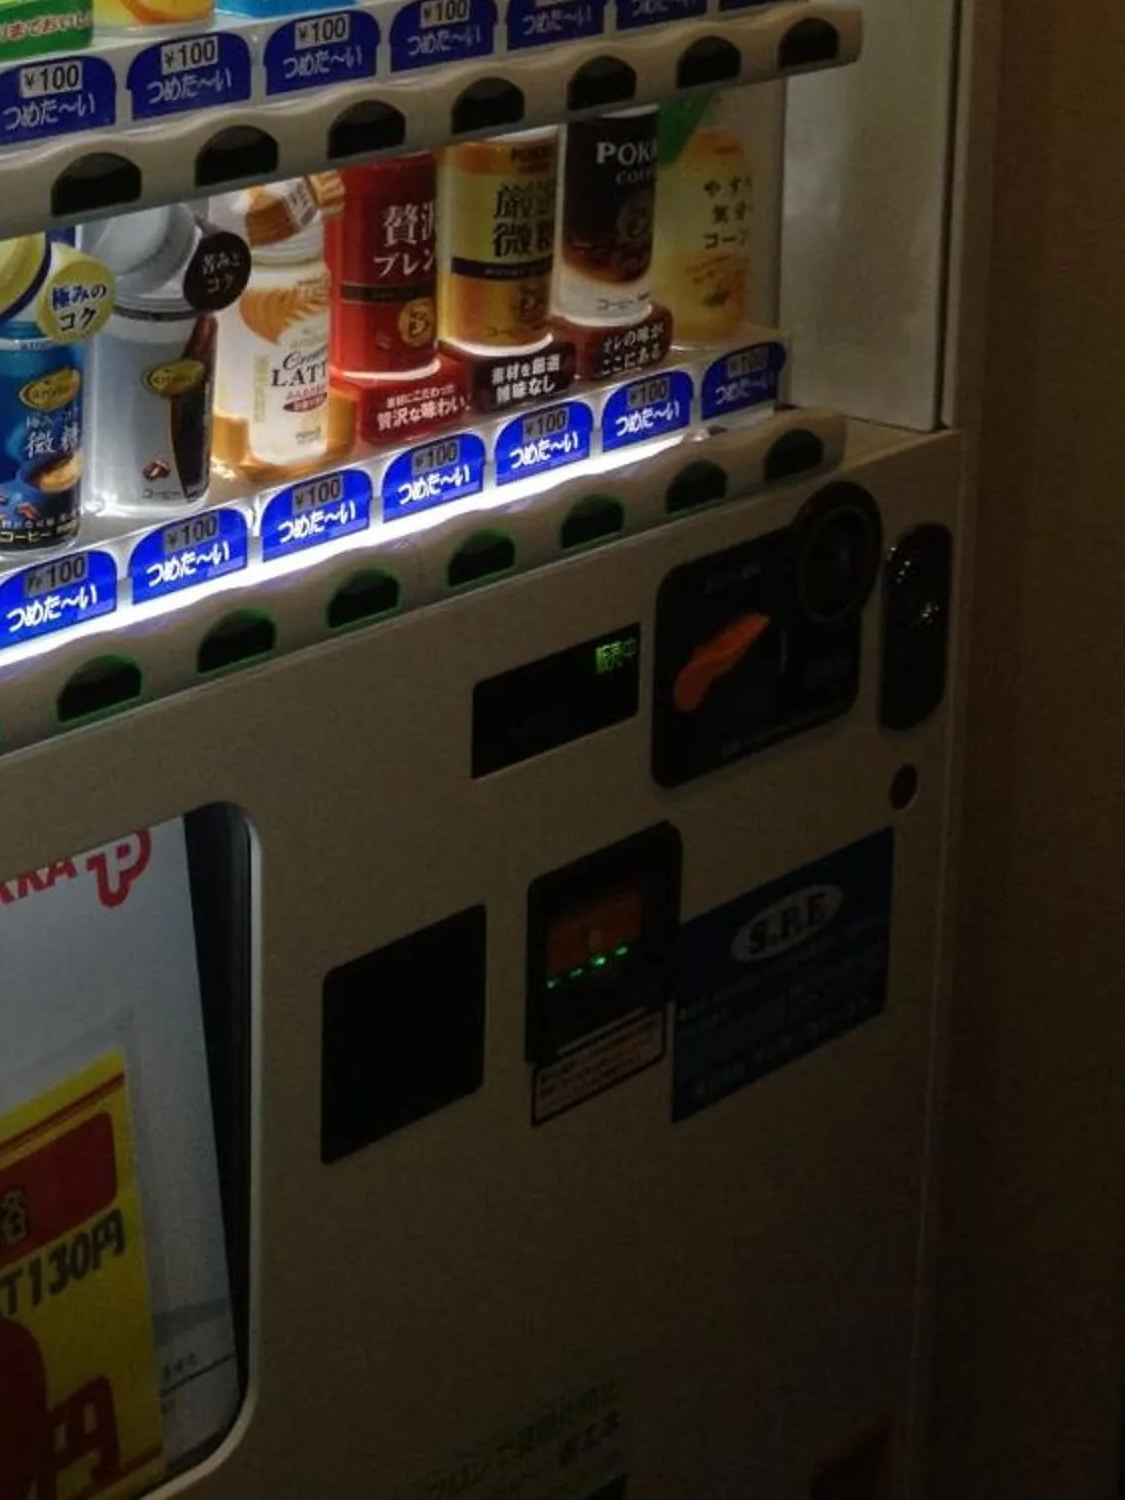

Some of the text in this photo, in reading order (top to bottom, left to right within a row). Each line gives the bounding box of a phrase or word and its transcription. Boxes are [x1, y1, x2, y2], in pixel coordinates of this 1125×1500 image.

[423, 0, 469, 22] ¥100
[298, 17, 347, 42] ¥100
[164, 41, 216, 67] ¥100
[24, 65, 79, 90] ¥100
[53, 283, 107, 310] 極みの
[60, 308, 97, 332] コク
[525, 409, 566, 437] ¥100
[414, 443, 458, 470] ¥100
[295, 477, 340, 506] ¥100
[165, 516, 217, 546] ¥100
[28, 556, 87, 589] ¥100
